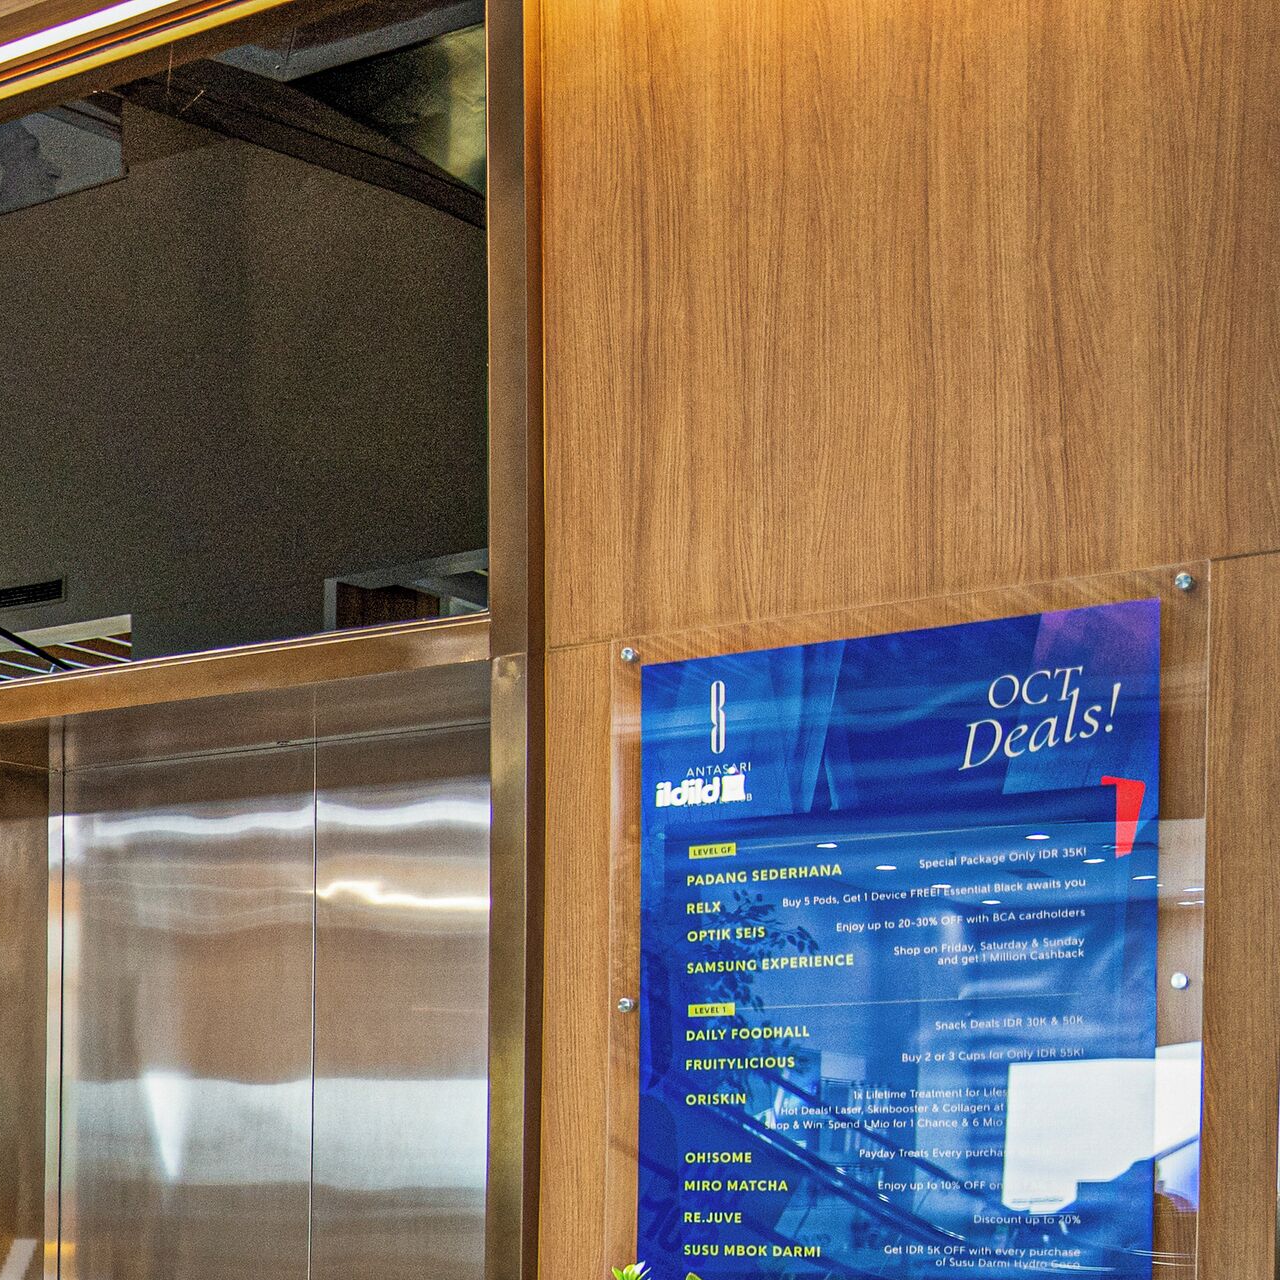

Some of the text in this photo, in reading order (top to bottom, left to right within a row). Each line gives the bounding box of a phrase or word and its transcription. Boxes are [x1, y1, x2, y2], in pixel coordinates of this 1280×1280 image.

[988, 666, 1083, 709] OCT
[958, 682, 1121, 771] Deals!
[693, 846, 731, 856] LEVEL GF
[919, 847, 1087, 870] Special Package Only IDR 35K!
[687, 864, 842, 886] PADANG SEDERHANA
[782, 879, 1086, 909] Buy 5 Pods, Get 1 Device FREE! Essential Black awaits you
[687, 902, 721, 914] RELX
[836, 908, 1085, 934] Enjoy up to 20-30% OFF with BCA cardholders
[687, 927, 765, 942] OPTIK SEIS
[894, 946, 920, 957] Shop
[941, 942, 976, 954] Friday,
[980, 939, 1027, 951] Saturday
[1031, 938, 1038, 947] &
[1043, 937, 1084, 949] Sunday
[687, 954, 854, 974] SAMSUNG EXPERIENCE
[937, 948, 1084, 967] and get 1 Million Cashback
[694, 1006, 726, 1014] LEVEL 1
[935, 1015, 1083, 1030] Snack Deals IDR 30K & 50K
[686, 1026, 809, 1041] DAILY FOODHALL
[902, 1053, 921, 1064] Buy
[925, 1053, 931, 1061] 2
[934, 1053, 945, 1061] or
[948, 1052, 955, 1060] 3
[958, 1051, 986, 1062] Cups
[989, 1051, 1003, 1060] for
[1007, 1049, 1033, 1061] Only
[1037, 1048, 1056, 1057] IDR
[686, 1056, 795, 1071] FRUITYLICIOUS
[686, 1093, 746, 1106] ORISKIN
[853, 1091, 863, 1099] 1x
[866, 1089, 906, 1099] Lifetime
[910, 1088, 962, 1098] Treatment
[965, 1088, 980, 1097] for
[781, 1102, 1004, 1115] Hot Deals! Laser, Skinbooster & Collagen at
[764, 1120, 789, 1130] Shop
[793, 1120, 800, 1129] &
[828, 1120, 860, 1130] Spend
[870, 1119, 889, 1129] Mio
[893, 1119, 907, 1128] for
[910, 1118, 913, 1127] 1
[917, 1118, 958, 1127] Chance
[962, 1118, 969, 1127] &
[972, 1118, 979, 1127] 6
[983, 1117, 1003, 1127] Mio
[685, 1152, 752, 1164] OH!SOME
[859, 1148, 1007, 1160] Payday Treats Every purcha
[684, 1180, 788, 1192] MIRO MATCHA
[878, 1181, 907, 1192] Enjoy
[910, 1182, 923, 1192] up
[927, 1181, 937, 1190] to
[940, 1181, 960, 1190] 10%
[964, 1181, 985, 1190] OFF
[684, 1213, 742, 1224] RE.JUVE
[973, 1215, 1081, 1227] Discount up to 20%
[684, 1245, 821, 1258] SUSU MBOK DARMI
[884, 1245, 1081, 1259] Get IDR 5K OFF with every purchase
[935, 1258, 946, 1267] of
[949, 1258, 974, 1268] Susu
[978, 1258, 1010, 1268] Darmi
[1014, 1259, 1048, 1271] Hydro
